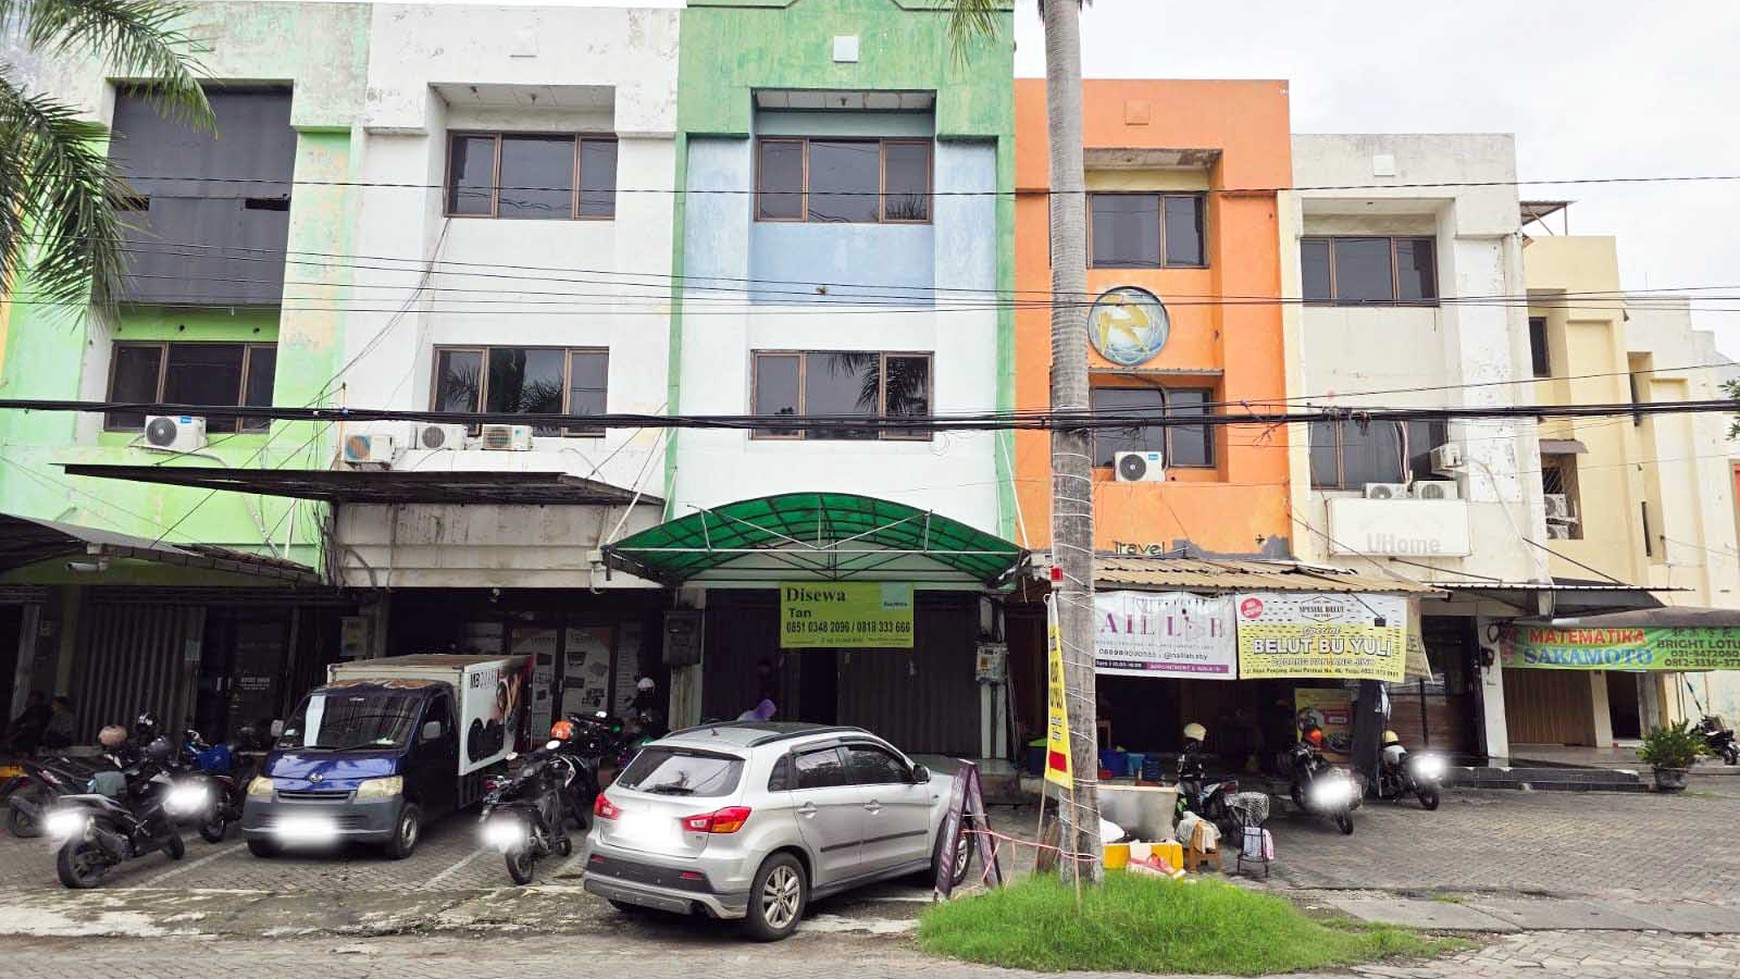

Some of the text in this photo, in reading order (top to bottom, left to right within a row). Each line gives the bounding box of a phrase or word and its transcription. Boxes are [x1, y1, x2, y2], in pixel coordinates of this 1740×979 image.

[1366, 533, 1441, 553] UHome
[786, 587, 846, 602] Disewa
[788, 607, 812, 618] Tan
[786, 621, 806, 633] 0851
[808, 621, 828, 633] 0348
[830, 621, 849, 633] 2096
[878, 621, 893, 633] 333
[895, 621, 911, 633] 666
[1099, 613, 1155, 636] AIL
[1529, 628, 1646, 645] MATEMATIKA
[1657, 639, 1705, 649] BRIGHT
[1253, 638, 1313, 655] BELUT
[1320, 639, 1345, 656] BU
[1351, 639, 1392, 657] YULI
[1523, 646, 1653, 666] SAKAMOTO
